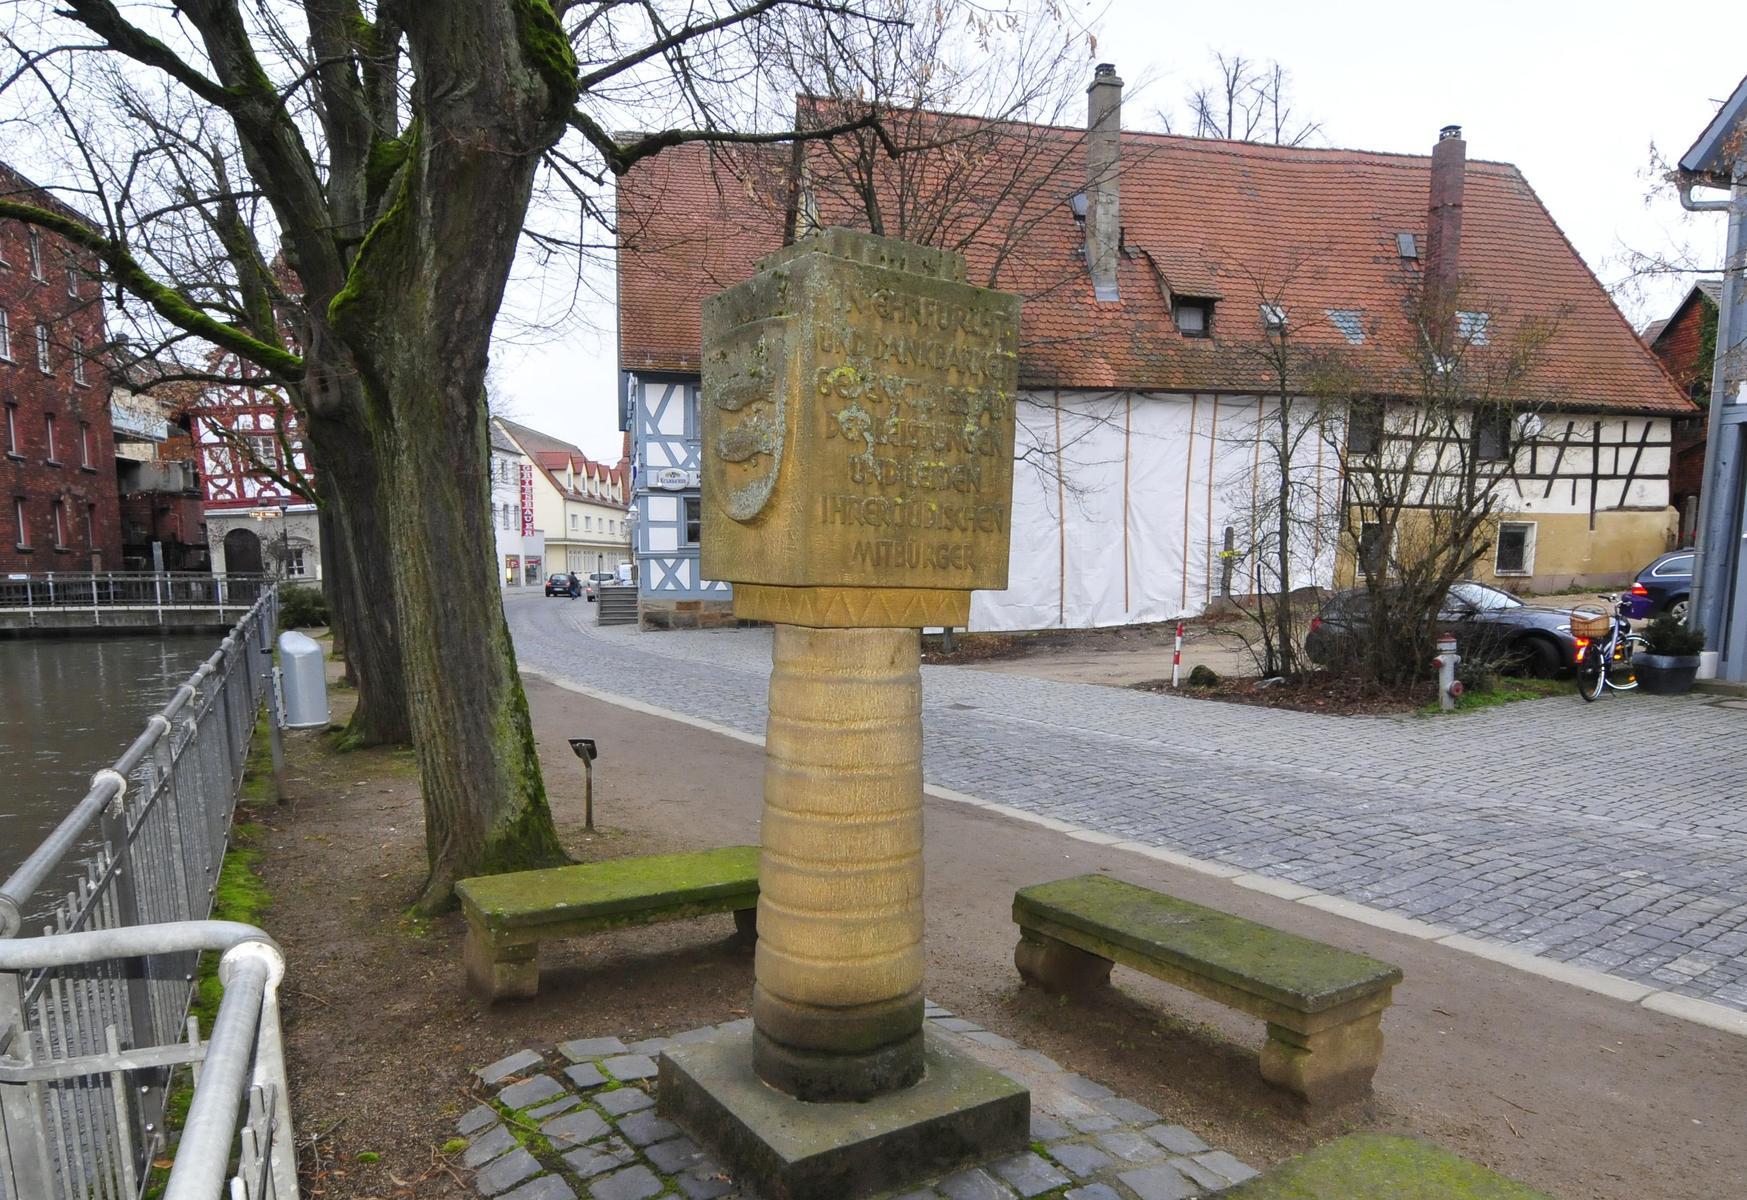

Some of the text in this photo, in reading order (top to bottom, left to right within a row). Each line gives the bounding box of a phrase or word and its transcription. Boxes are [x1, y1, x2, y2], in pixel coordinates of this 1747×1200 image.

[848, 455, 898, 486] UND
[821, 493, 1004, 533] IHRER JÜDISCHEN
[851, 534, 977, 571] MITBÜRGER
